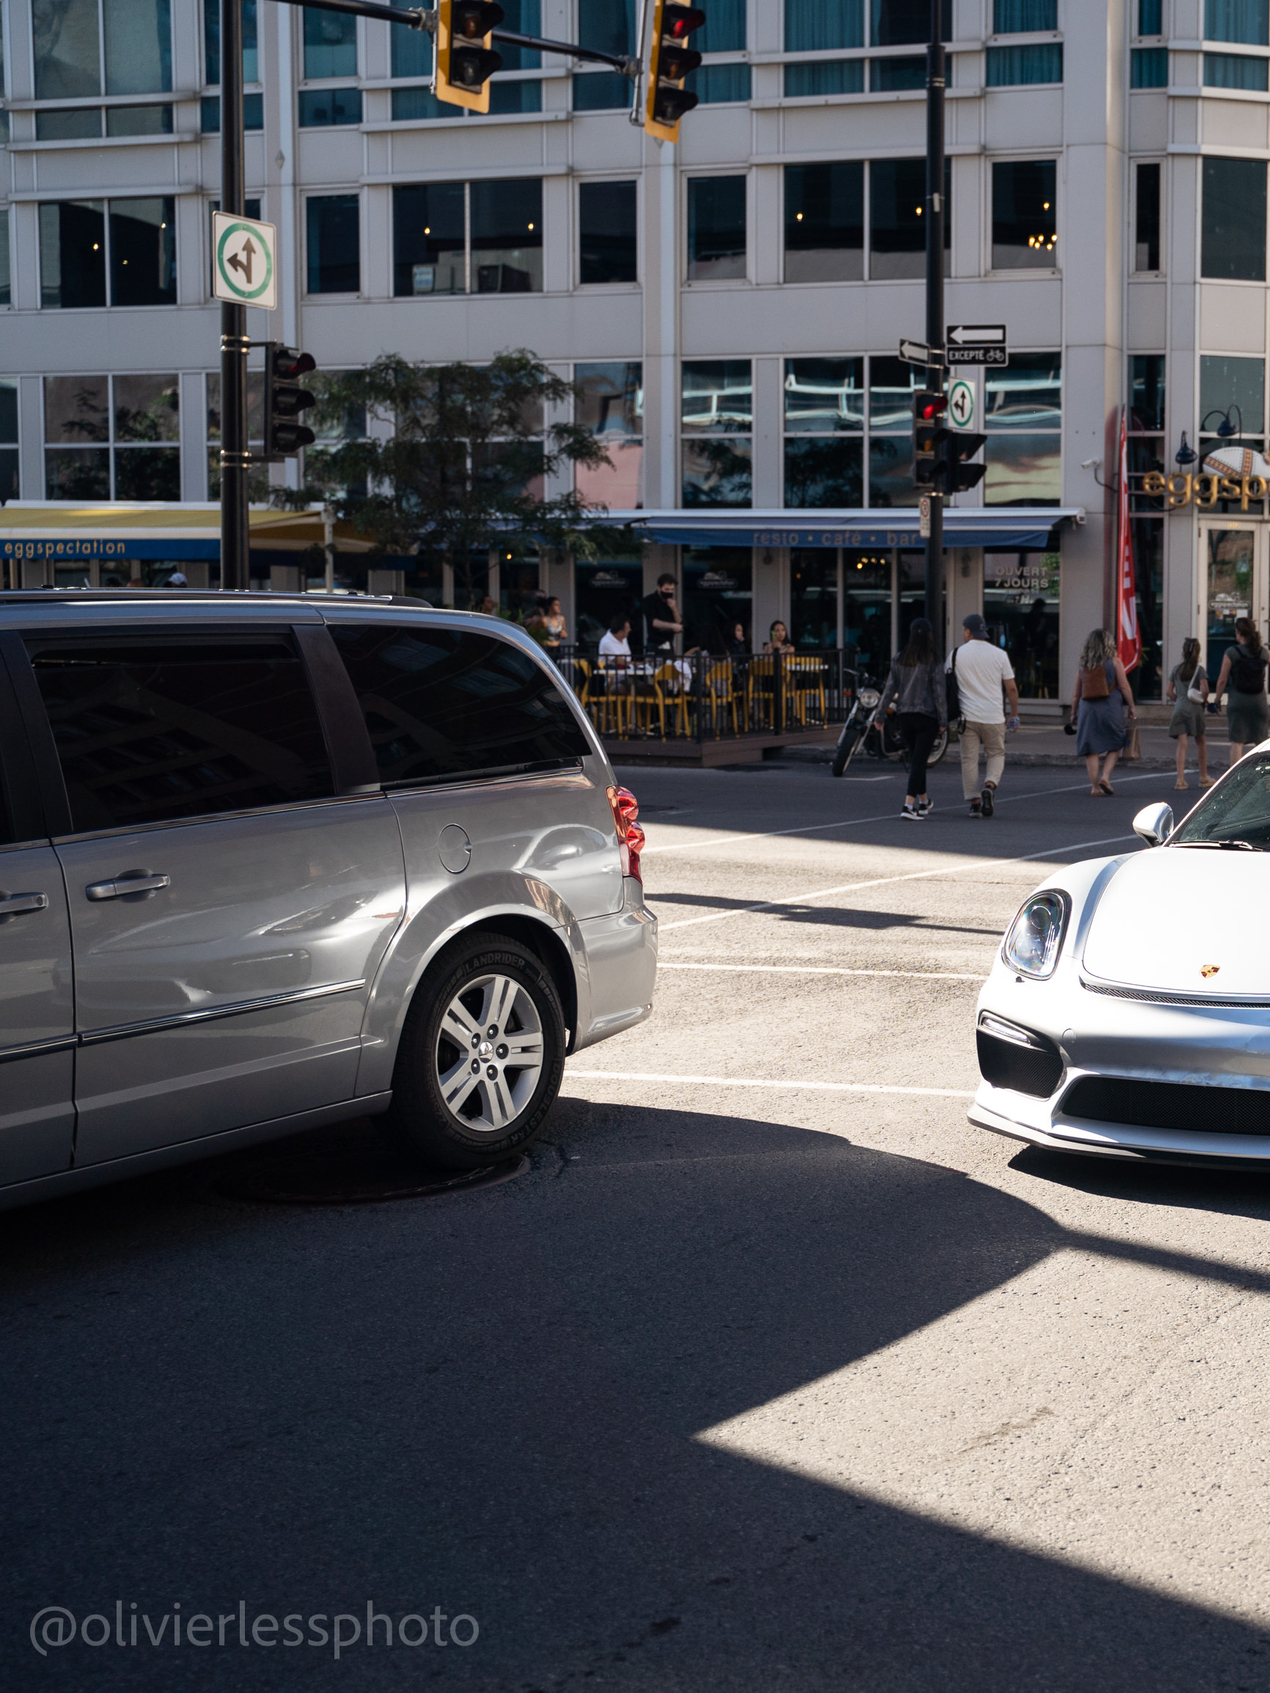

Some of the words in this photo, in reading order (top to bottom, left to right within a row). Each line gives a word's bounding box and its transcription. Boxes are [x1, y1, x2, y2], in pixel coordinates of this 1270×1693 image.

[949, 348, 985, 360] EXCEPTÉ
[753, 532, 799, 546] resto
[821, 530, 862, 546] café
[887, 531, 918, 546] bar
[4, 539, 126, 559] eggspectation
[996, 566, 1048, 577] OUVERT
[994, 578, 1002, 587] 7
[1004, 578, 1049, 589] JOURS
[465, 951, 525, 974] LANDRIDER
